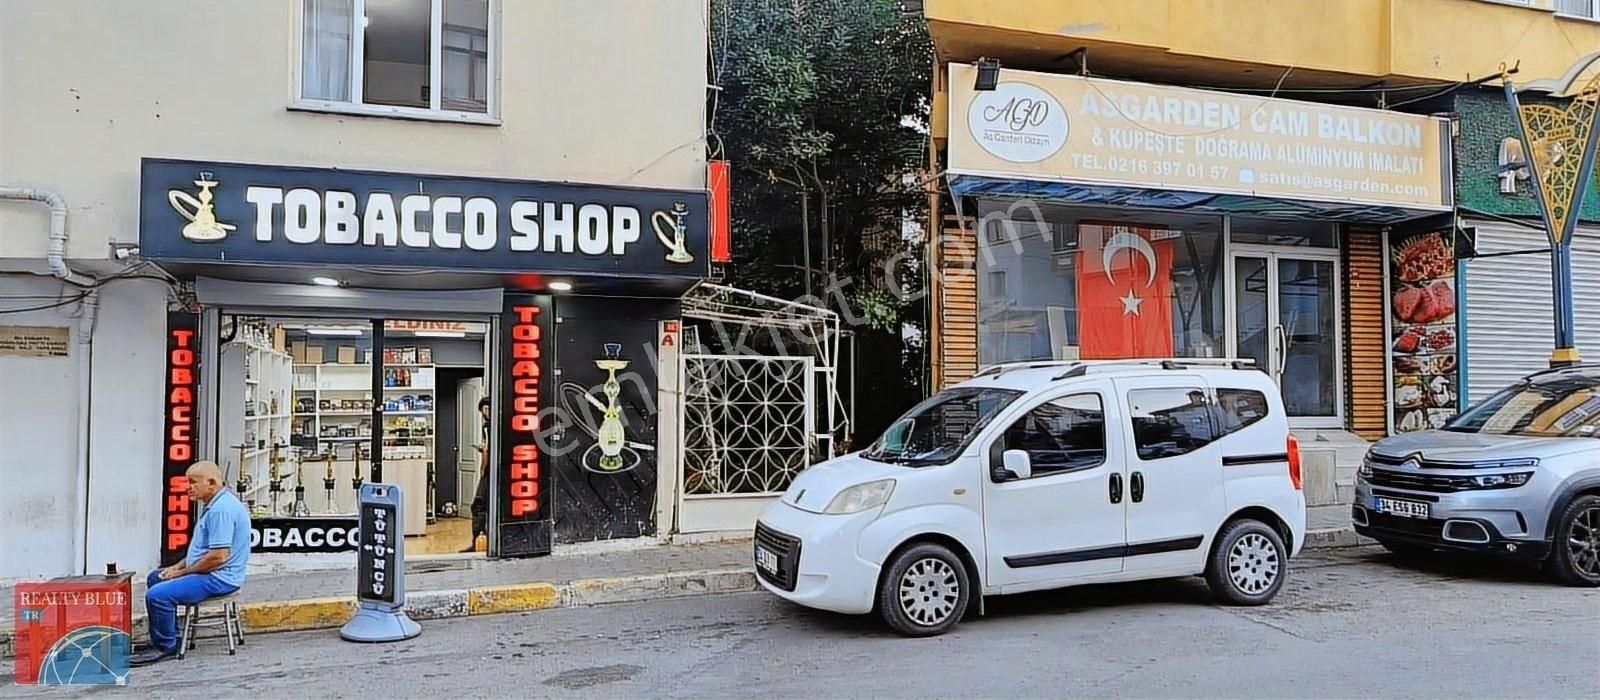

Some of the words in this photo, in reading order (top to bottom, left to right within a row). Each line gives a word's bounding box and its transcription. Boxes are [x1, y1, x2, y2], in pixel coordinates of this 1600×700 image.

[1078, 90, 1240, 130] ASGARDEN
[1250, 108, 1308, 137] CAM
[1317, 112, 1421, 149] BALKON
[1091, 127, 1104, 147] &
[1195, 134, 1271, 161] DOĞRAMA
[1153, 160, 1181, 176] 397
[1187, 162, 1204, 178] 01
[1210, 165, 1229, 180] 57
[246, 186, 498, 250] TOBACCO
[510, 200, 641, 255] SHOP
[169, 330, 193, 461] TOBACCO
[512, 305, 540, 431] TOBACCO
[168, 475, 191, 550] SHOP
[511, 444, 539, 516] SHOP
